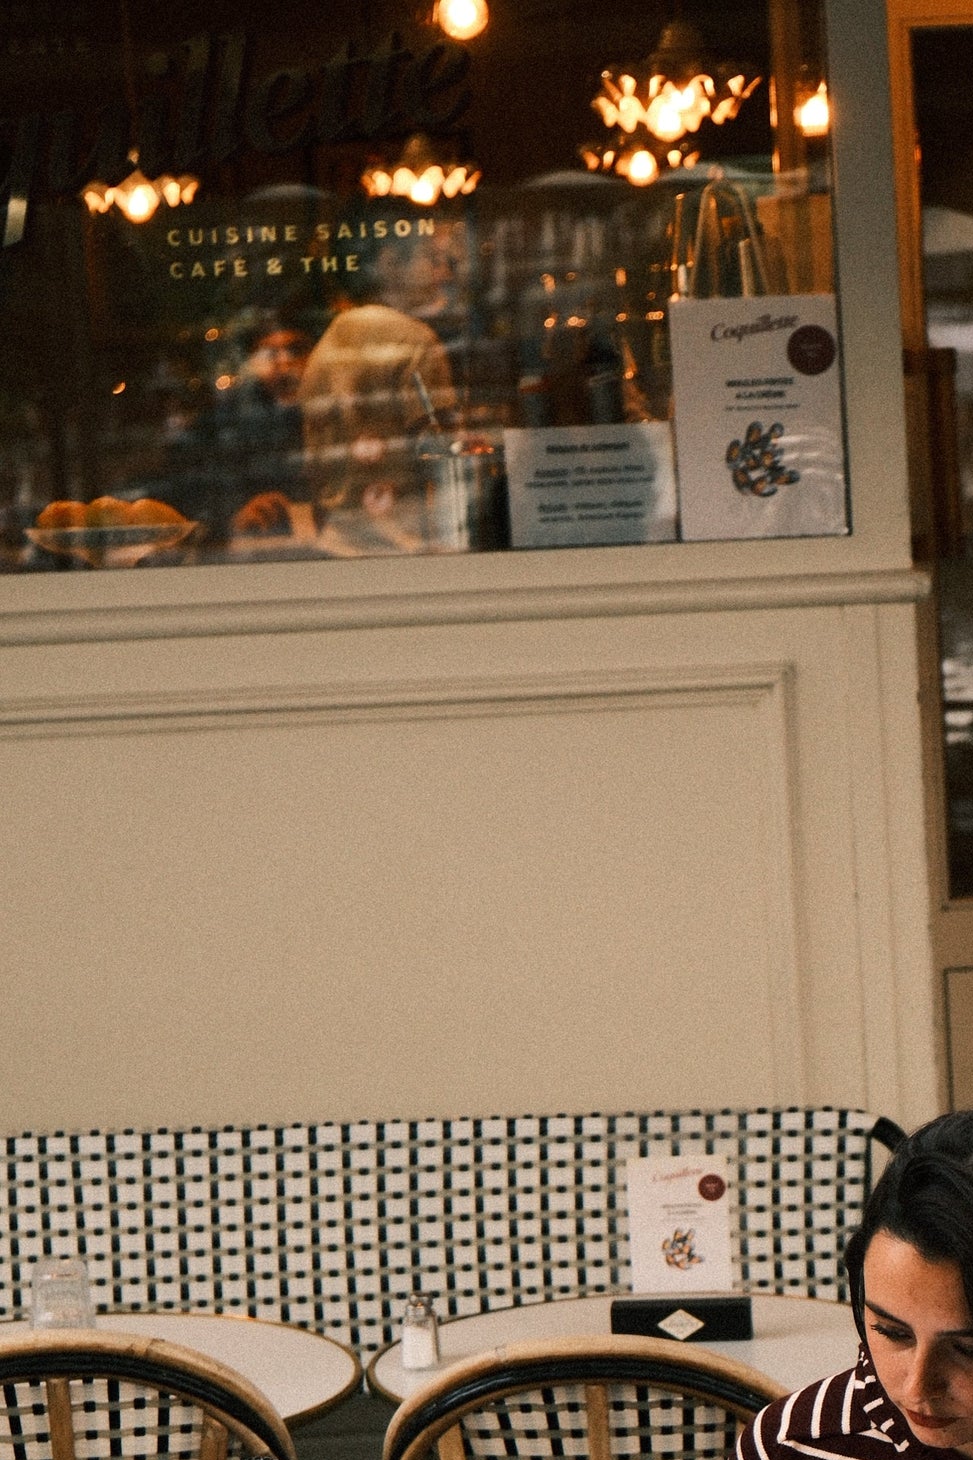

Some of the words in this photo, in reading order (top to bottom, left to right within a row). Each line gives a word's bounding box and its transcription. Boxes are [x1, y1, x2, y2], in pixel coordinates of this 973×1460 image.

[167, 224, 298, 246] CUISINE
[314, 218, 435, 240] SAISON
[266, 257, 283, 276] &
